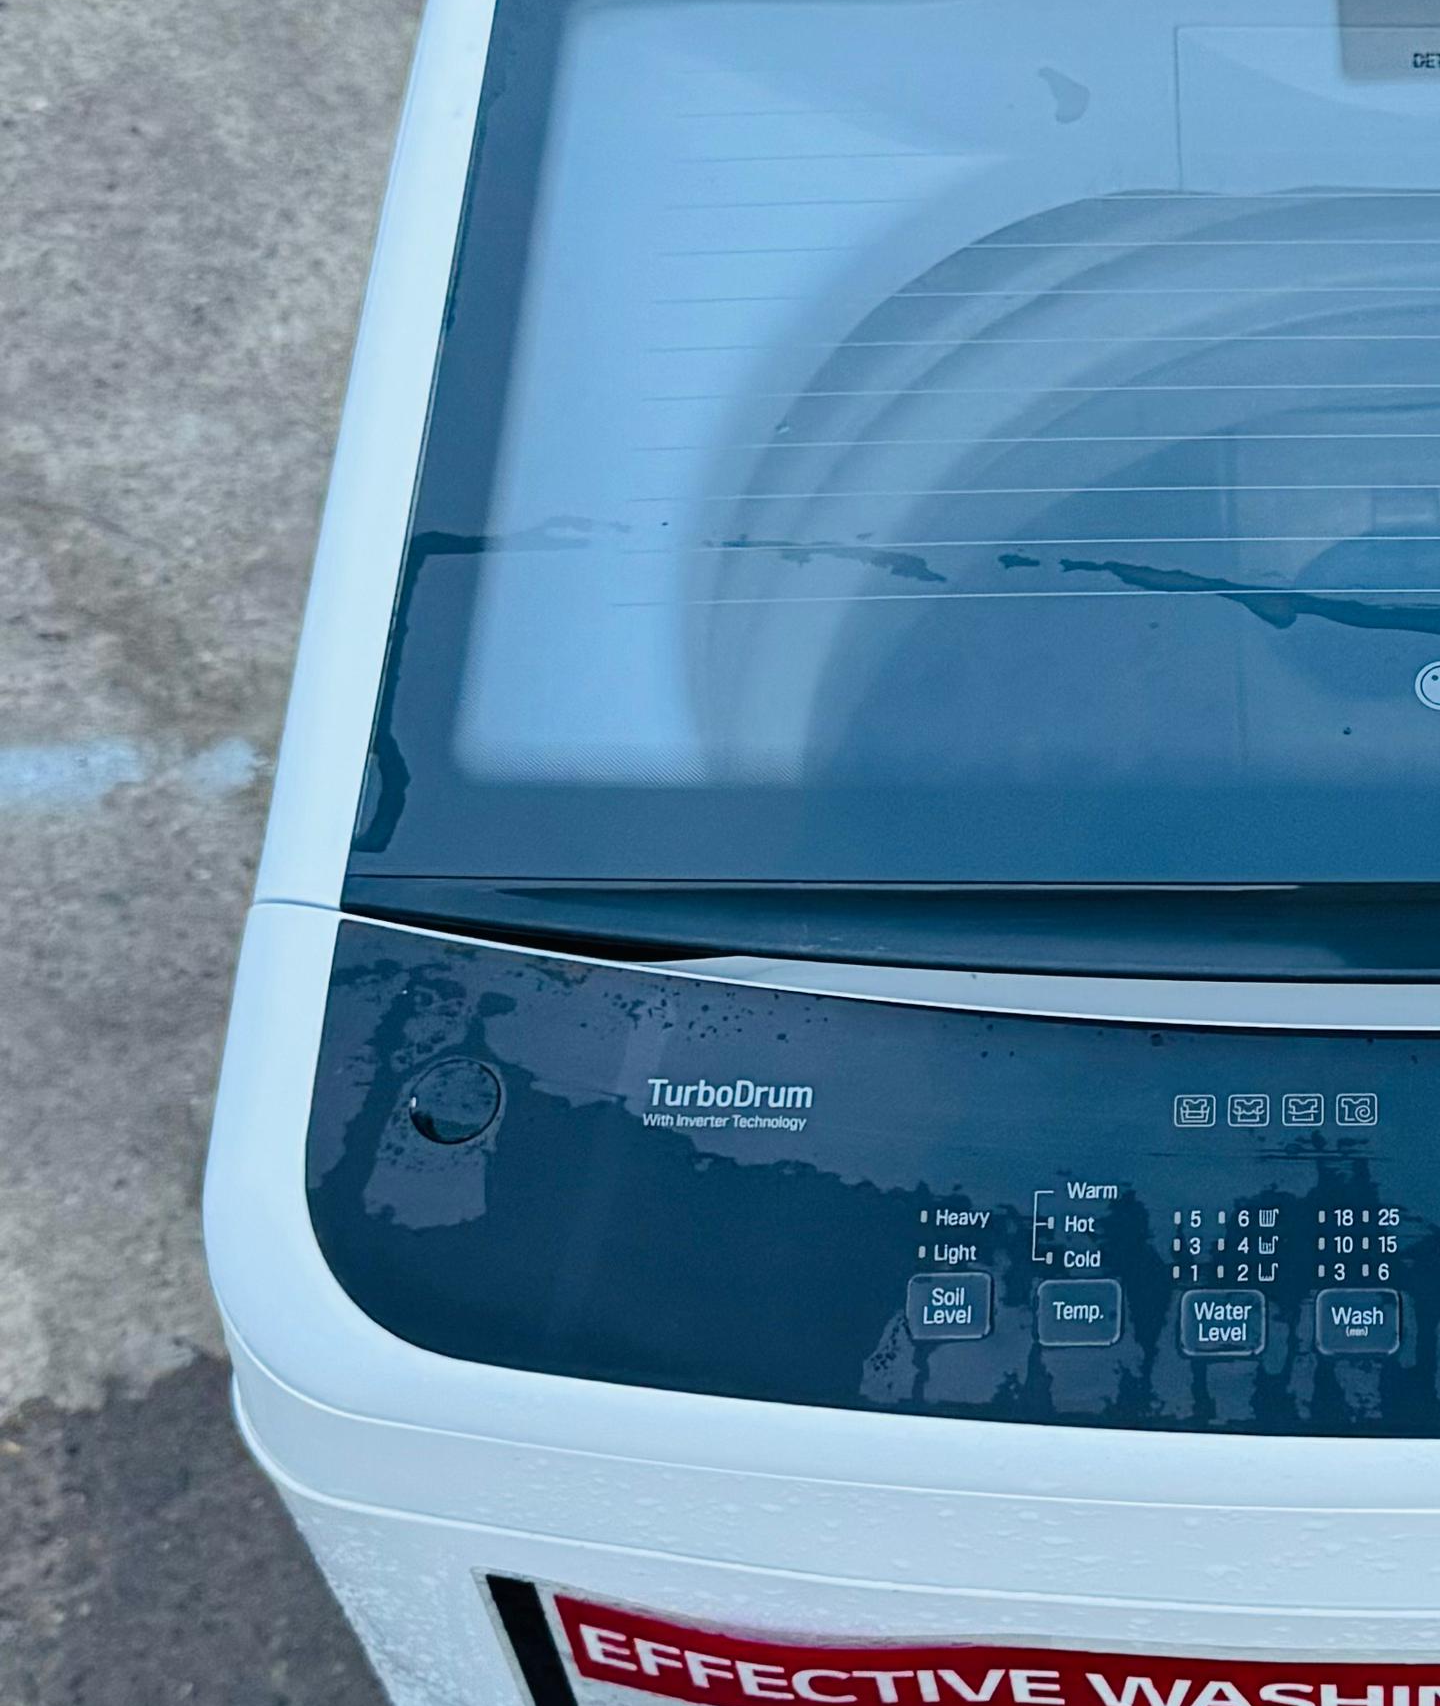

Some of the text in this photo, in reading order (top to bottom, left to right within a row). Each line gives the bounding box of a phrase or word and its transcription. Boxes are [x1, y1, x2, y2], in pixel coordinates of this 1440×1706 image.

[648, 1079, 813, 1108] TurboDrum
[642, 1113, 807, 1131] With Inverter Technology
[1067, 1182, 1118, 1200] Warm
[936, 1210, 990, 1229] Heavy
[1065, 1215, 1095, 1232] Hot
[1190, 1211, 1201, 1227] 5
[1238, 1211, 1249, 1227] 6
[1334, 1208, 1354, 1226] 18
[1378, 1208, 1400, 1226] 25
[1190, 1238, 1201, 1254] 3
[1238, 1238, 1249, 1254] 4
[1334, 1236, 1353, 1253] 10
[1378, 1236, 1398, 1253] 15
[933, 1245, 977, 1265] Light
[1064, 1251, 1100, 1267] Cold
[1191, 1265, 1198, 1281] 1
[1238, 1265, 1249, 1281] 2
[1334, 1263, 1346, 1280] 3
[1378, 1263, 1390, 1280] 6
[932, 1288, 965, 1306] Soil
[923, 1306, 972, 1324] Level
[1053, 1302, 1104, 1321] Temp.
[1194, 1302, 1252, 1321] Water
[1331, 1306, 1384, 1326] Wash
[1199, 1324, 1247, 1341] Level
[579, 1623, 1065, 1705] EFFECTIVE
